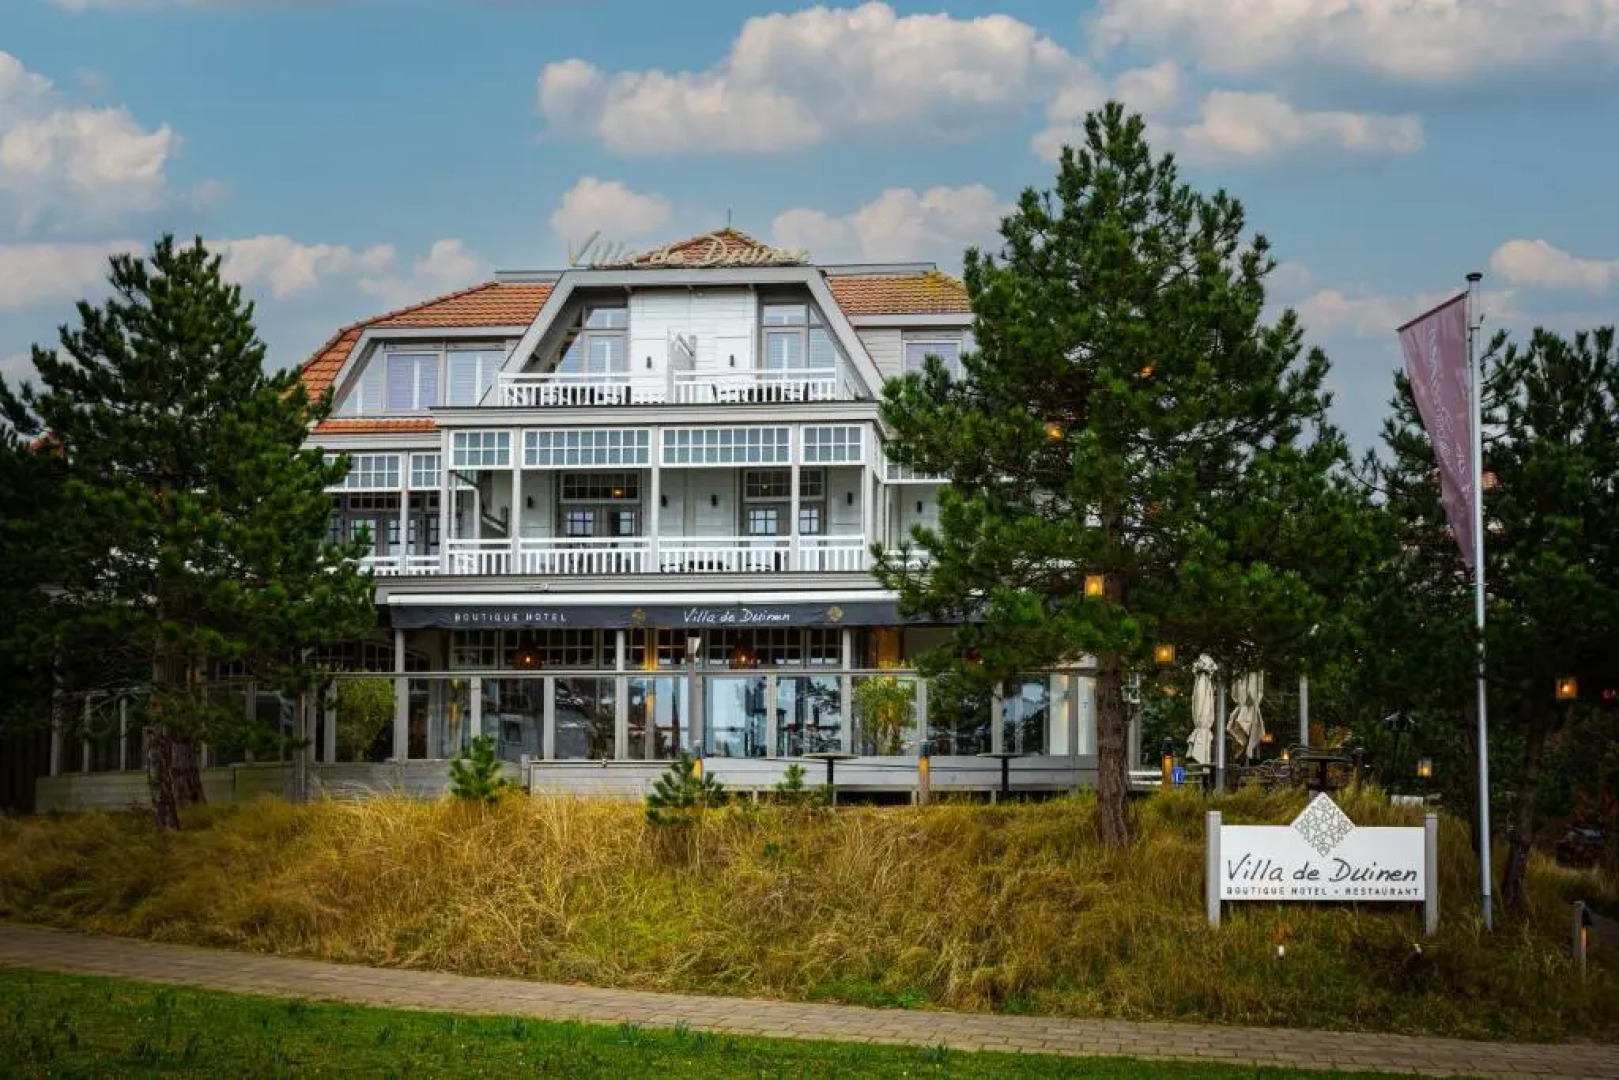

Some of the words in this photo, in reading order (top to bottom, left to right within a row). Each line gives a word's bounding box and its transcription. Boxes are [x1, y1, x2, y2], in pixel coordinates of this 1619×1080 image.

[454, 612, 519, 622] BOUTIQUE
[525, 612, 567, 622] HOTEL
[684, 607, 716, 623] Villa
[720, 610, 736, 622] de
[1227, 853, 1284, 882] Villa
[1292, 861, 1320, 882] de
[1328, 857, 1417, 882] Duinen
[1226, 886, 1285, 896] BOUTIQUE
[1291, 886, 1327, 896] HOTEL
[1345, 887, 1418, 896] RESTAURANT
